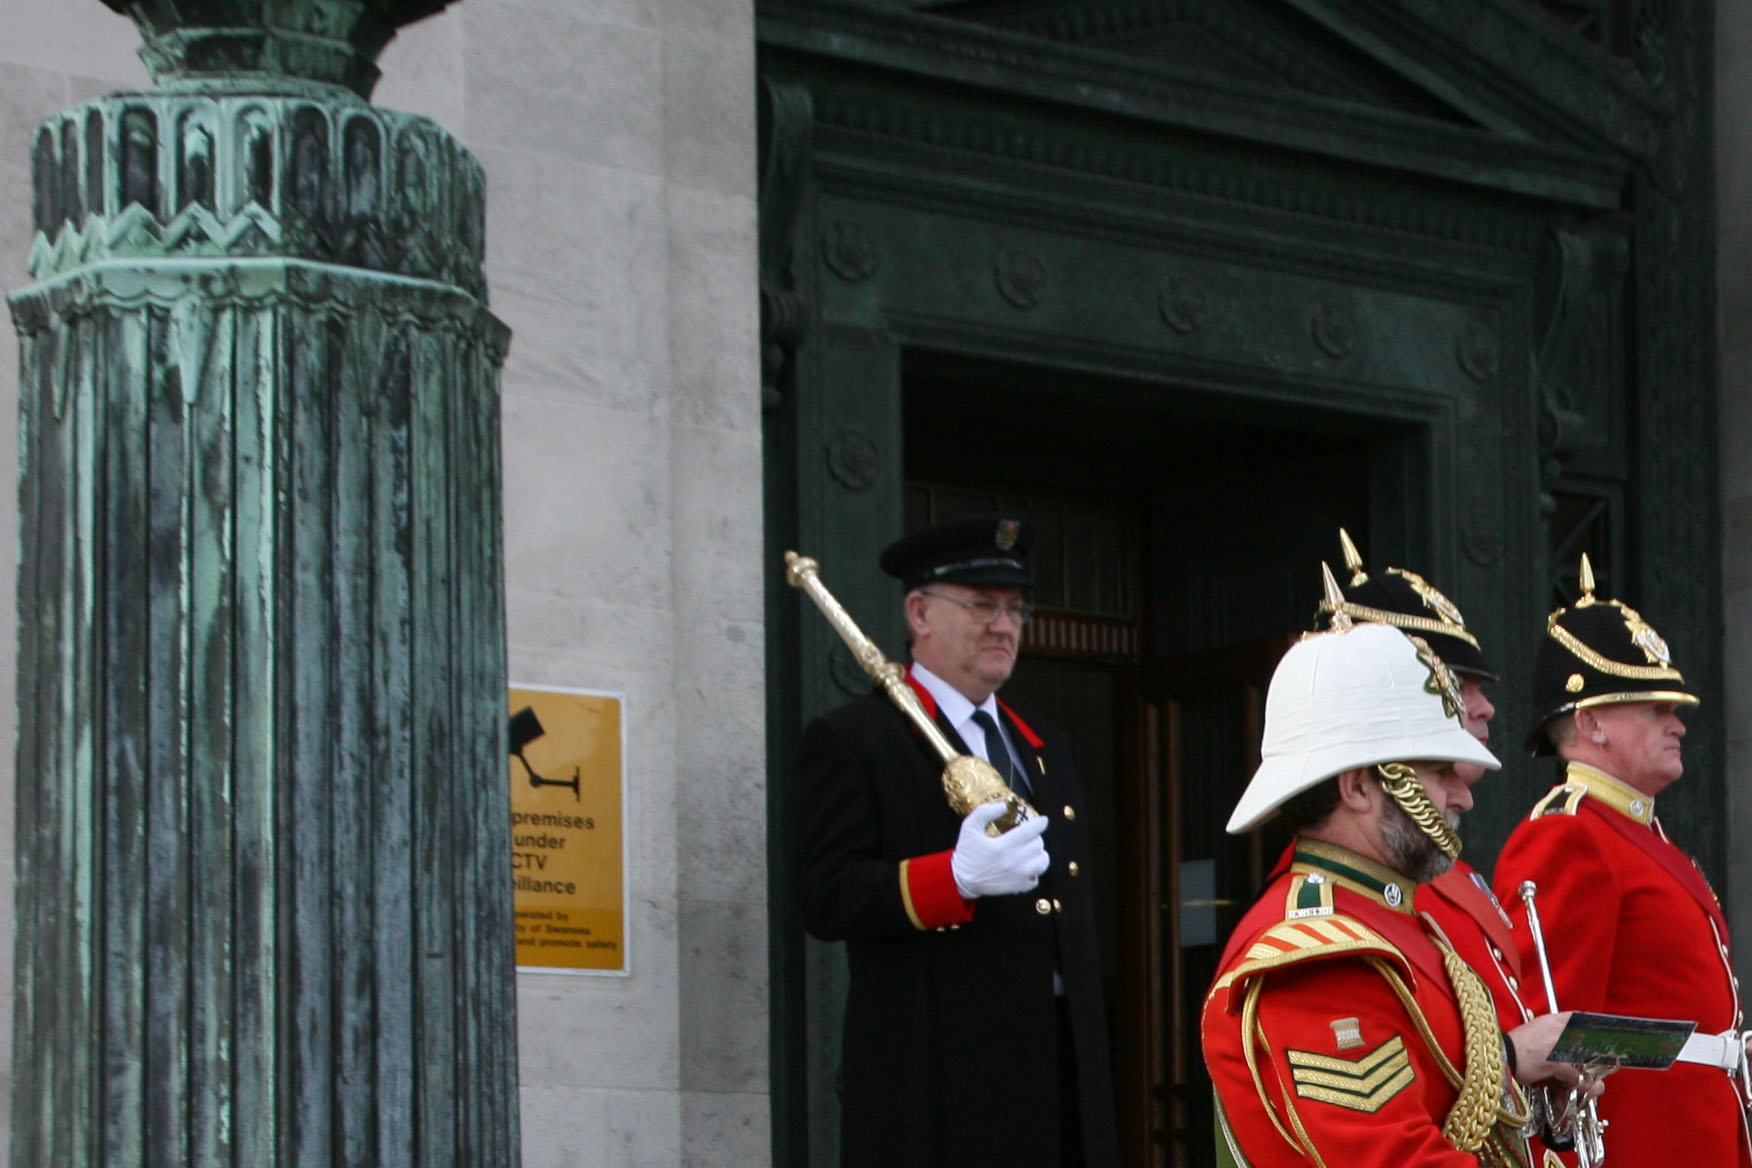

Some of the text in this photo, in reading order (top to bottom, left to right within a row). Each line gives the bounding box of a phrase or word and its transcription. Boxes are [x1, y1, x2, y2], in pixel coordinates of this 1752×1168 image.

[512, 810, 595, 829] premises
[514, 832, 566, 850] under
[513, 875, 576, 895] illance
